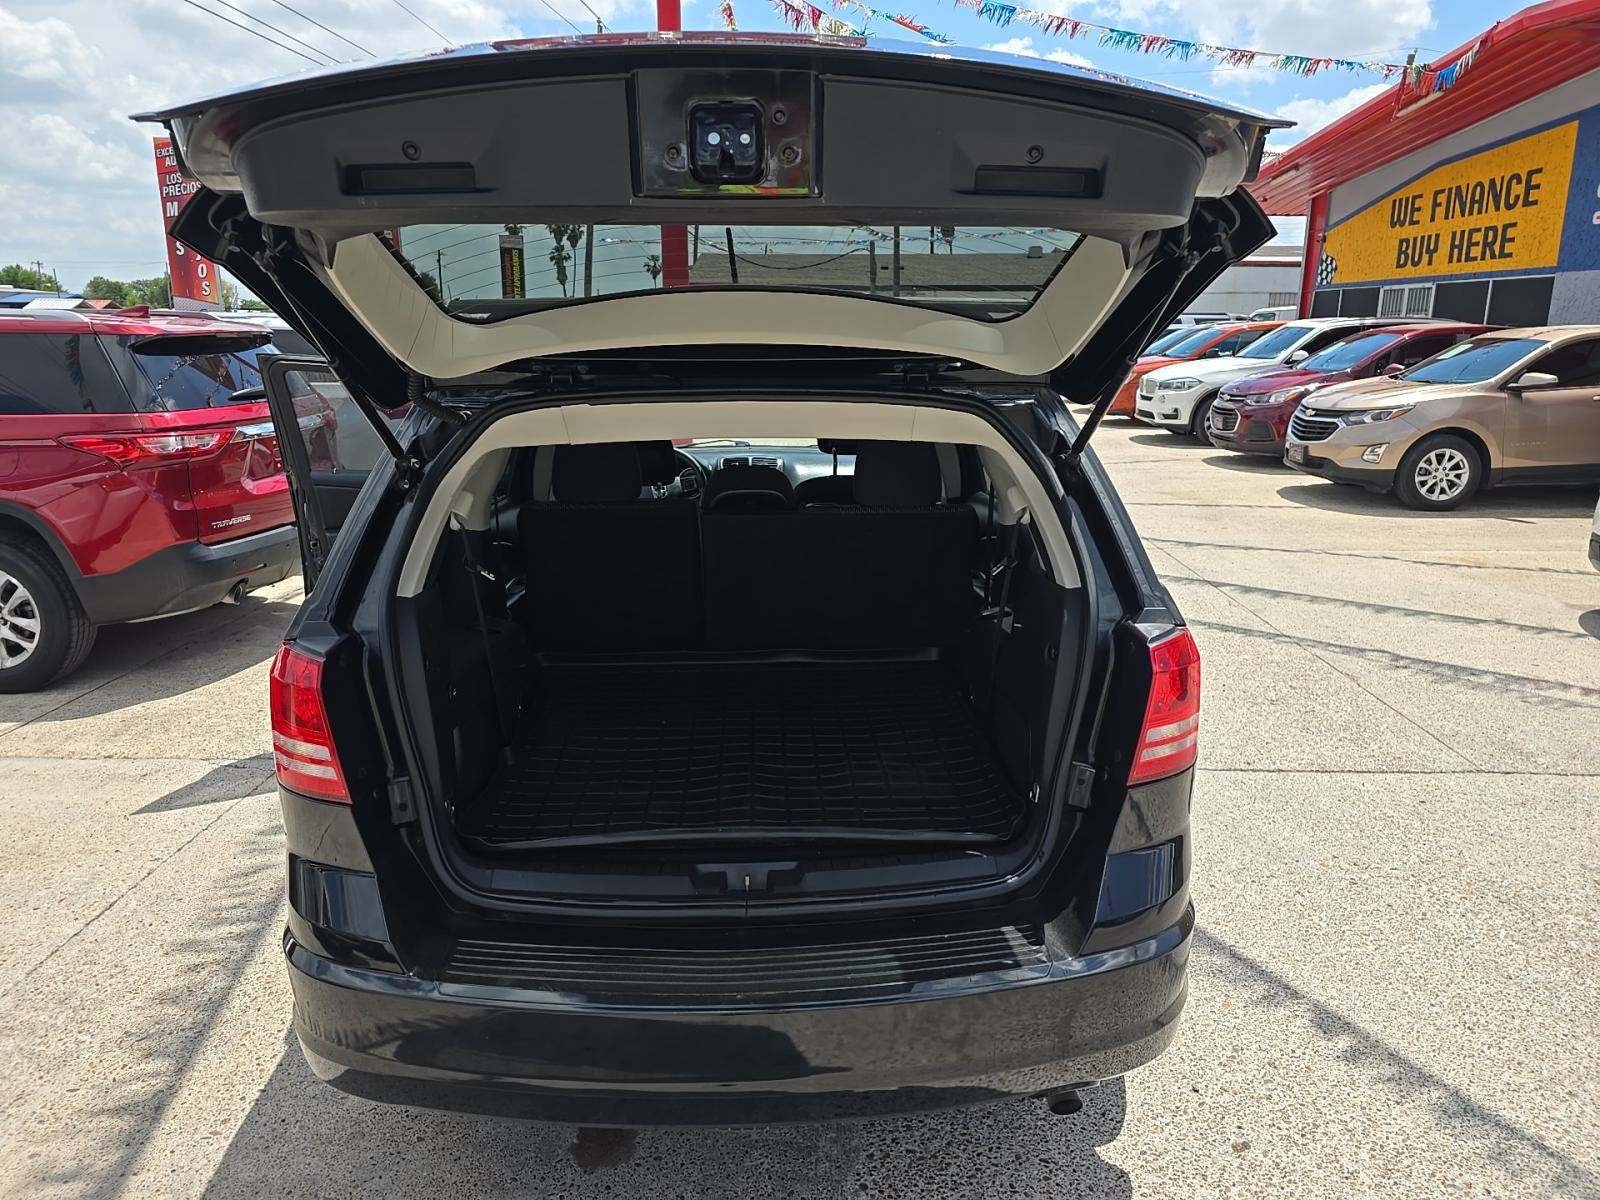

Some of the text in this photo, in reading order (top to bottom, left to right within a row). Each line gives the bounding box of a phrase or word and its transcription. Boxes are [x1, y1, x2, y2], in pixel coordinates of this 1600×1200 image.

[156, 147, 174, 157] EXCE
[165, 156, 177, 167] AU
[166, 172, 182, 185] LOS
[163, 180, 202, 197] PRECIOS
[1389, 167, 1543, 229] WE FINANCE
[1395, 221, 1518, 269] BUY HERE
